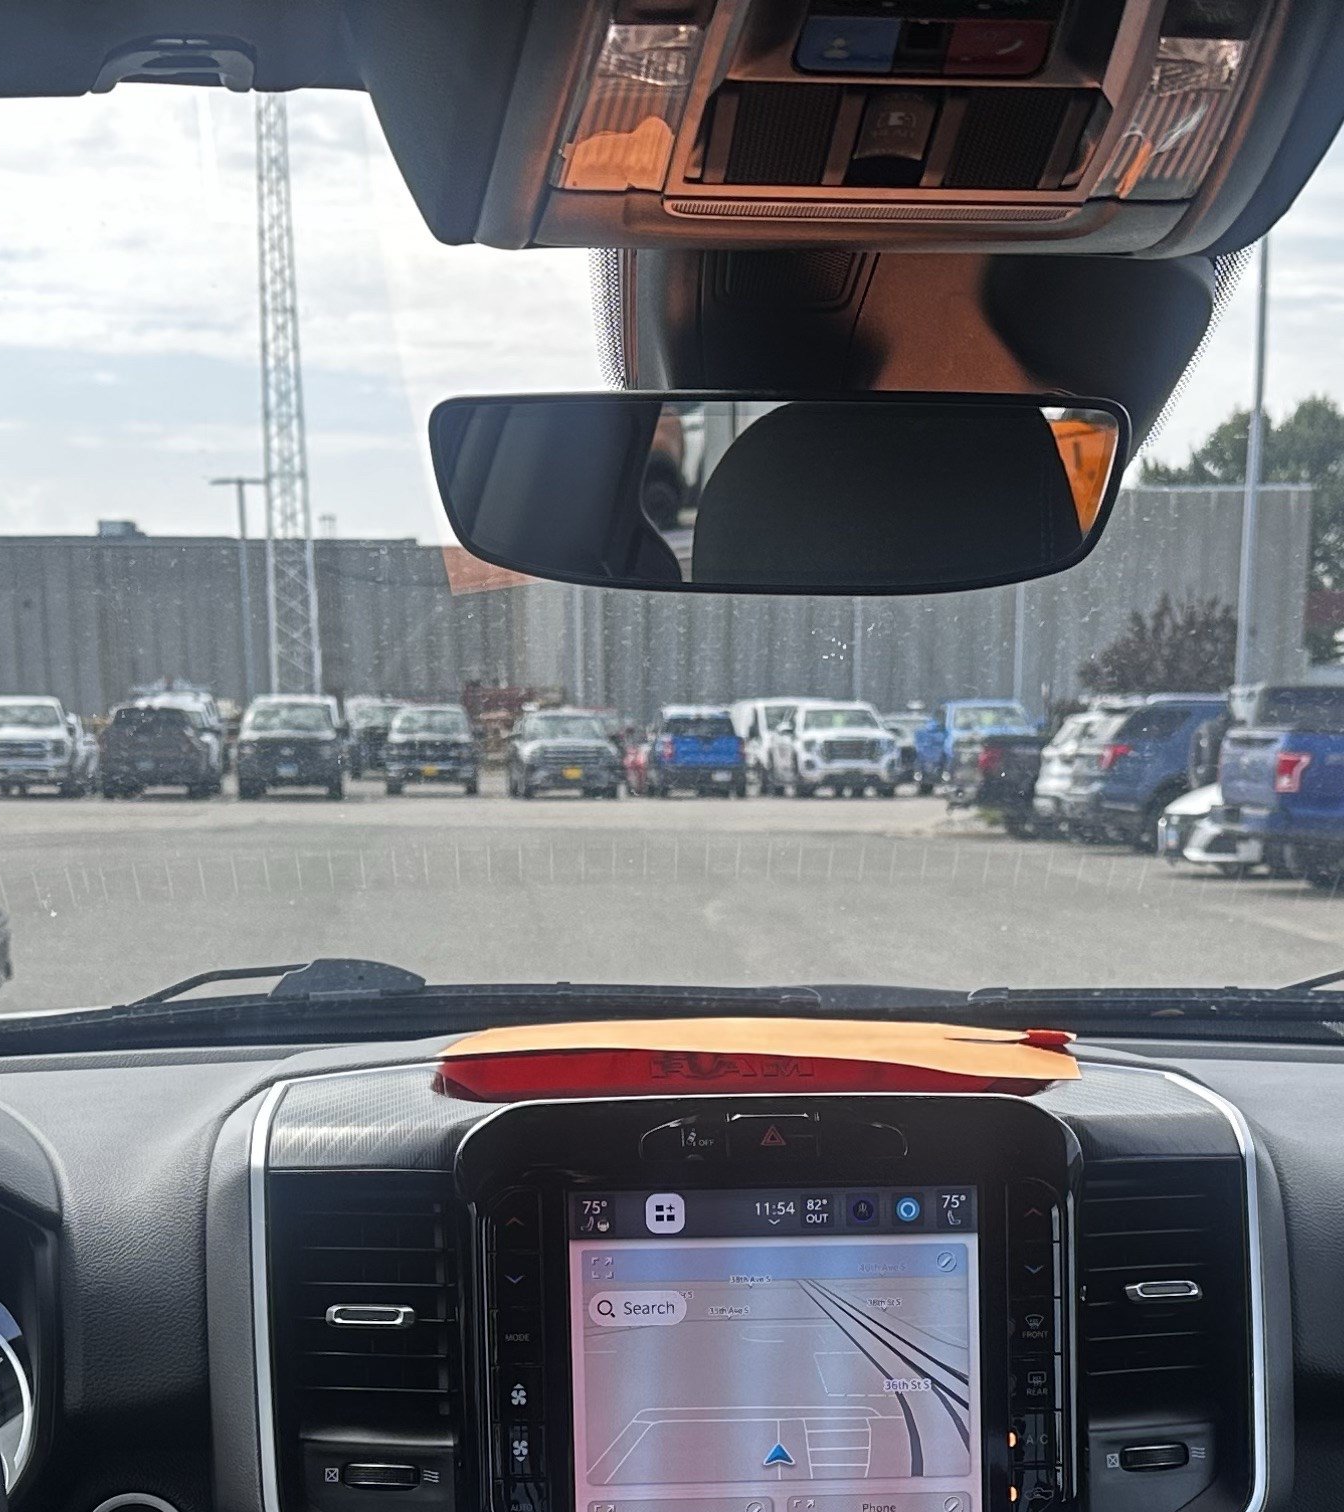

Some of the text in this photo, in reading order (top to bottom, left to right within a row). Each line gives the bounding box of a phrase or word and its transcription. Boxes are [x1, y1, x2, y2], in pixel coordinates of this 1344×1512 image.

[755, 1202, 795, 1217] 11:54
[806, 1213, 829, 1224] OUT
[623, 1300, 675, 1316] Search
[505, 1333, 530, 1342] MODE
[1022, 1330, 1048, 1339] FRONT
[884, 1379, 910, 1391] 36th
[1026, 1387, 1048, 1396] REAR
[862, 1503, 896, 1512] Phone
